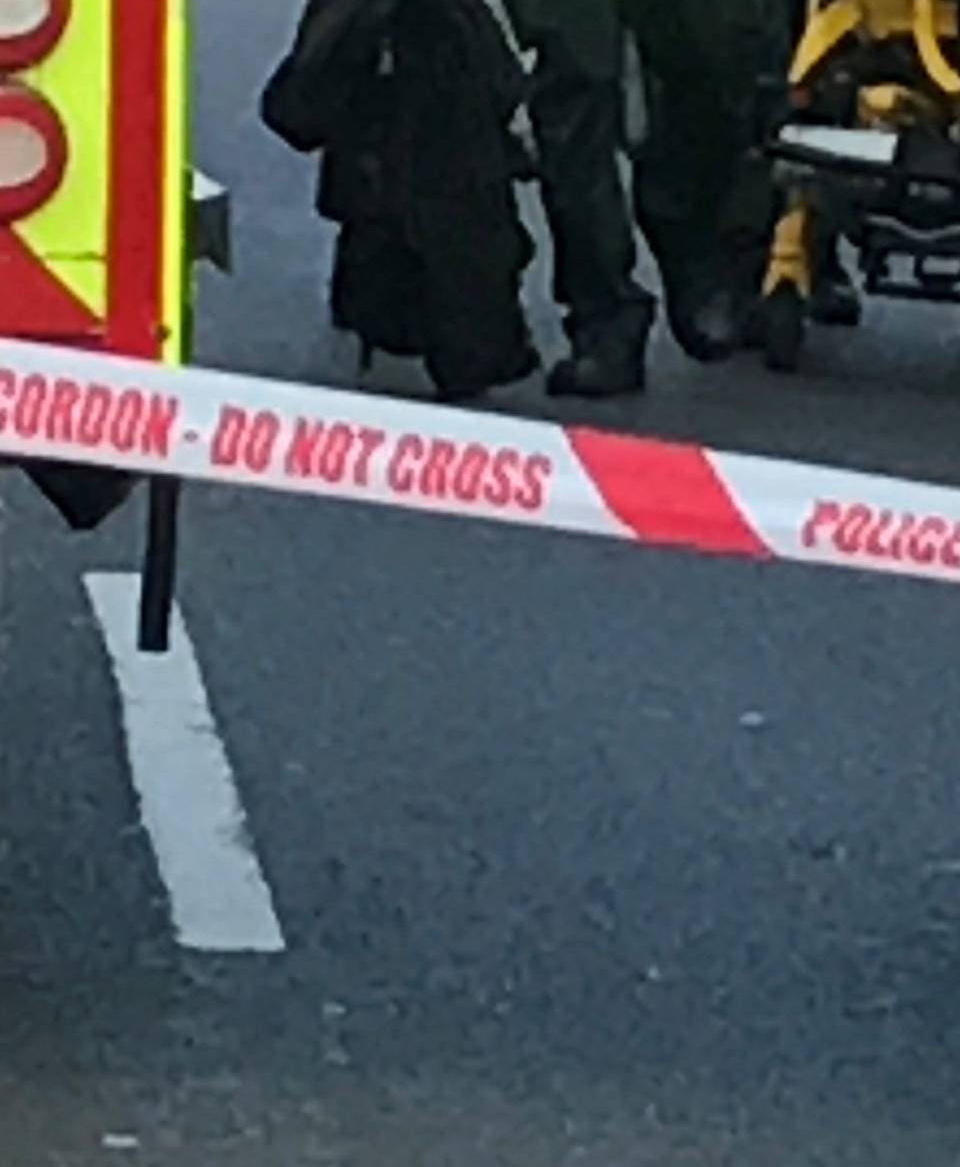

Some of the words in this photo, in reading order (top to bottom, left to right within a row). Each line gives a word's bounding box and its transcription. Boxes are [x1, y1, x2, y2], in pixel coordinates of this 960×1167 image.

[210, 404, 281, 472] DO
[284, 416, 385, 487] NOT
[387, 433, 553, 510] CROSS
